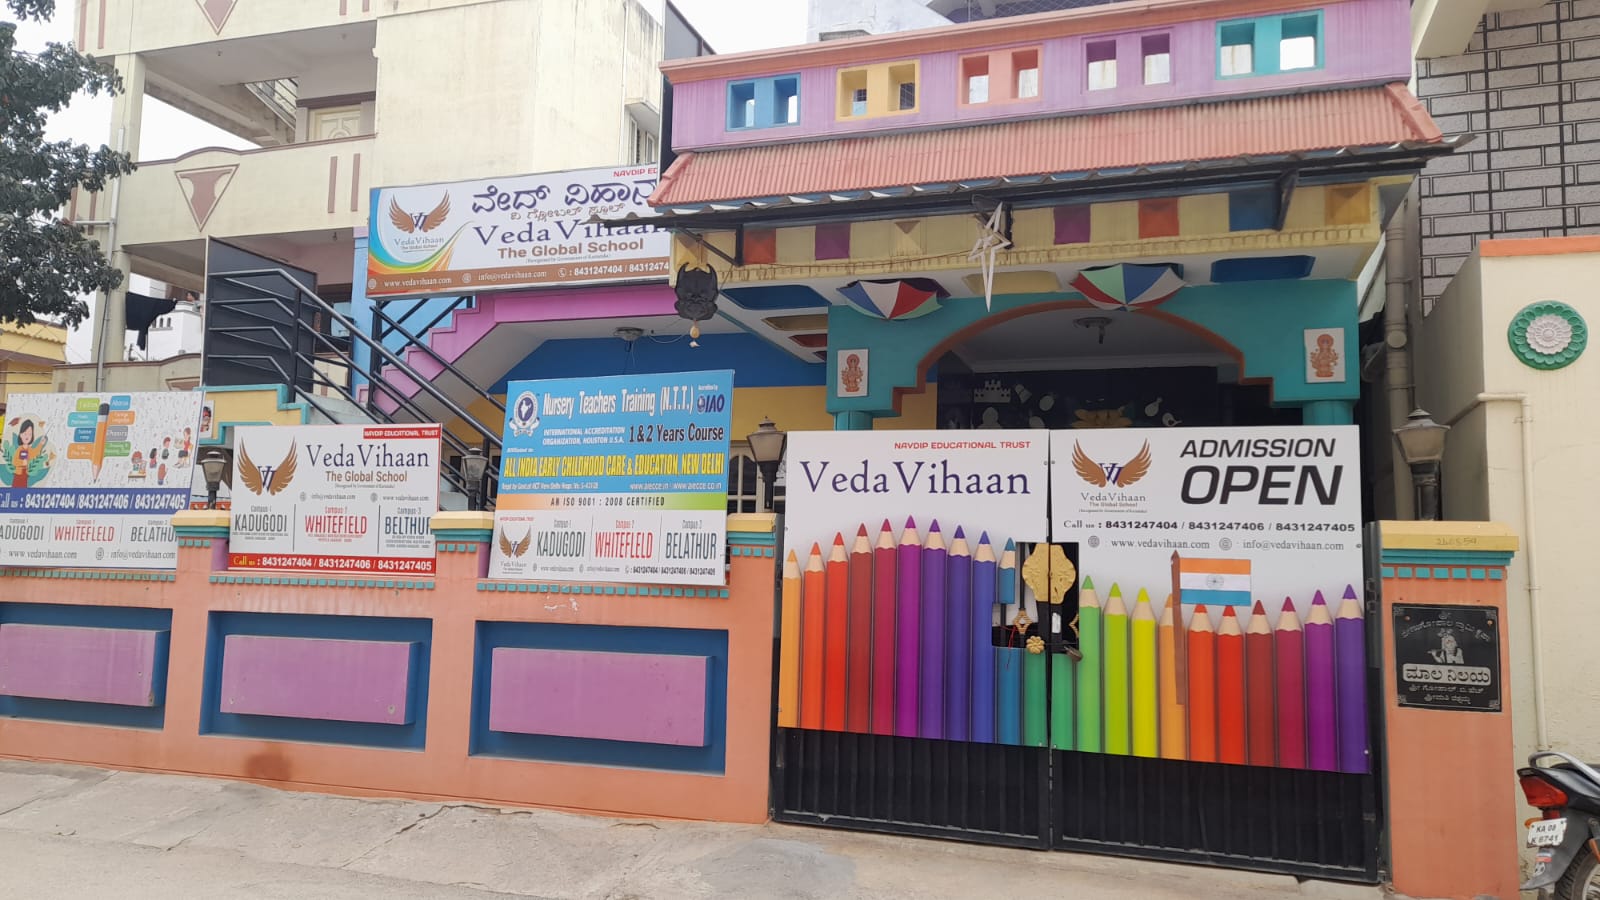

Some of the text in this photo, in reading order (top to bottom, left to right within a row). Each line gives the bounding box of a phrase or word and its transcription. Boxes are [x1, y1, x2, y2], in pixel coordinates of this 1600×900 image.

[613, 168, 646, 178] NAVDIP
[497, 247, 527, 260] The
[532, 243, 583, 257] Global
[588, 238, 644, 253] School
[574, 264, 623, 276] 8431247404
[629, 262, 669, 273] 84312474
[543, 392, 575, 420] Nursery
[579, 390, 617, 414] Teachers
[621, 388, 656, 416] Training
[657, 424, 685, 442] Years
[688, 422, 724, 441] Course
[894, 440, 1031, 449] NAVDIP EDUCATIONAL TRUST
[1180, 438, 1336, 458] ADMISSION
[503, 457, 516, 478] ALL
[518, 456, 538, 477] INDIA
[539, 456, 560, 477] EARLY
[561, 455, 605, 477] CHILDHOOD
[606, 454, 627, 476] CARE
[682, 453, 700, 475] NEW
[701, 452, 724, 475] DELHI
[326, 470, 408, 482] The Global School
[1180, 465, 1344, 506] OPEN
[25, 493, 76, 509] 8431247404
[134, 494, 187, 509] 8431247405
[563, 497, 575, 506] ISO
[626, 496, 665, 506] CERTIFIED
[234, 514, 287, 532] KADUGODI
[305, 515, 367, 535] WHITEFIELD
[1063, 520, 1082, 528] Call
[1105, 520, 1178, 529] 8431247404
[1188, 521, 1265, 531] 8431247406
[1275, 522, 1355, 532] 8431247405
[0, 525, 44, 541] ADUGODI
[130, 526, 178, 542] BELATHU
[536, 531, 586, 557] KADUGODI
[665, 532, 717, 560] BELATHUR
[1111, 538, 1210, 549] www.vedavihaan.com
[1243, 540, 1344, 551] info@vedavihaan.com
[233, 556, 247, 566] Call
[262, 556, 312, 567] 8431247404
[318, 558, 371, 569] 8431247406
[377, 560, 432, 571] 8431247405
